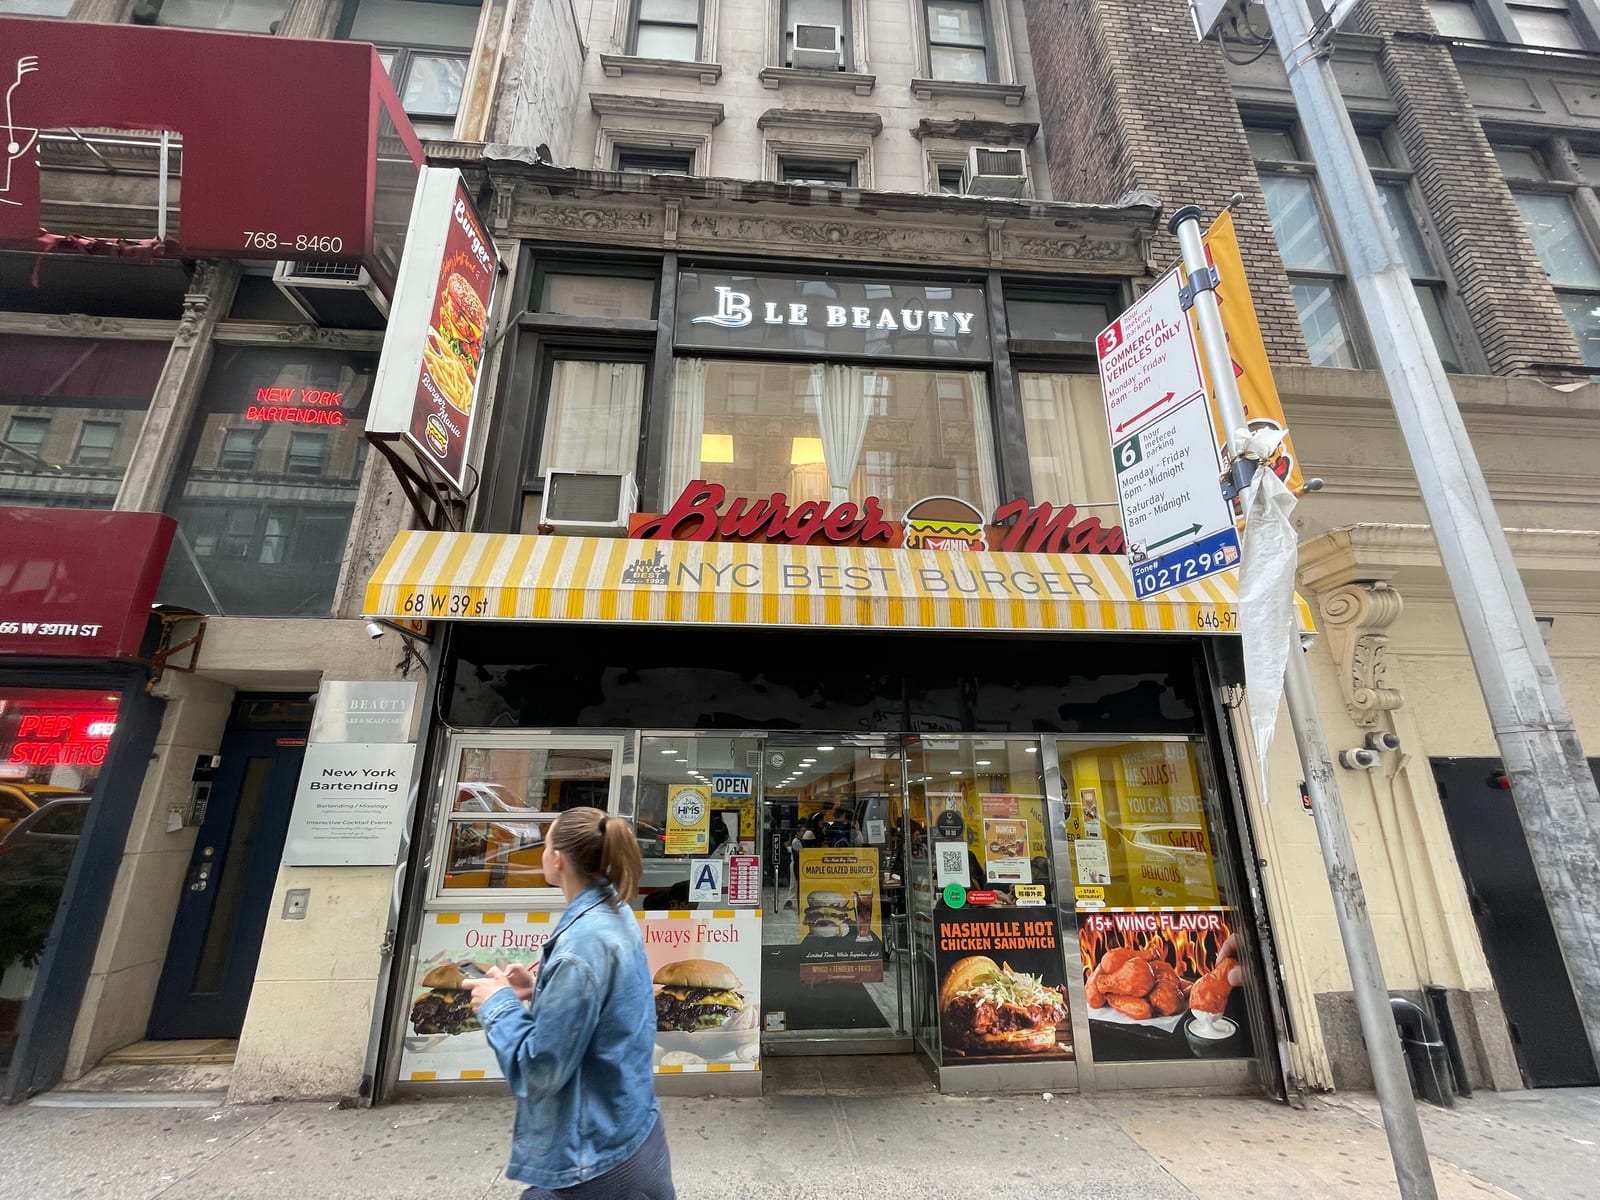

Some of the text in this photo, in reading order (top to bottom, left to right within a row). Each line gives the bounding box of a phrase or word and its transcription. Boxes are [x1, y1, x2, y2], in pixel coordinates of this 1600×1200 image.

[454, 198, 490, 262] Burger
[764, 302, 974, 334] LE BEAUTY
[1123, 308, 1139, 324] hour
[1125, 304, 1153, 332] metered
[1126, 316, 1151, 340] parking
[1103, 328, 1118, 353] 3
[1105, 319, 1168, 372] COMMERCIAL
[1107, 320, 1182, 383] VEHICLES ONLY
[1109, 374, 1137, 399] Monday
[1142, 352, 1168, 376] Friday
[256, 387, 343, 406] NEW YORK
[422, 372, 446, 409] Burger
[1110, 393, 1128, 409] 6am
[1133, 376, 1152, 393] 6pm
[246, 406, 344, 425] BARTENDING
[1143, 427, 1161, 442] hour
[1144, 426, 1177, 450] metered
[1120, 440, 1136, 467] 6
[1146, 438, 1175, 458] parking
[1122, 468, 1154, 489] Monday
[1161, 446, 1191, 471] Friday
[1124, 485, 1142, 501] 6pm
[1148, 462, 1186, 488] Midnight
[629, 479, 894, 545] Burger
[1127, 490, 1166, 517] Saturday
[1128, 513, 1147, 528] 8am
[1153, 491, 1191, 516] Midnight
[636, 565, 661, 573] NYC
[676, 561, 1101, 596] NYC BEST BURGER
[1136, 553, 1212, 595] 102729
[404, 593, 488, 614] 68 W 39 st
[0, 622, 103, 637] 66 W 39TH ST
[322, 768, 397, 777] New York
[310, 781, 399, 793] Bartending
[716, 778, 749, 793] OPEN
[1127, 797, 1146, 813] YOU
[695, 864, 717, 890] A
[827, 866, 848, 874] GLAZED
[940, 921, 1054, 938] NASHVILLE HOT
[1087, 914, 1221, 931] 15+ WING FLAVOR
[465, 929, 550, 952] Our Burge
[644, 923, 740, 949] lways Fresh
[940, 937, 1056, 951] CHICKEN SANDWICH
